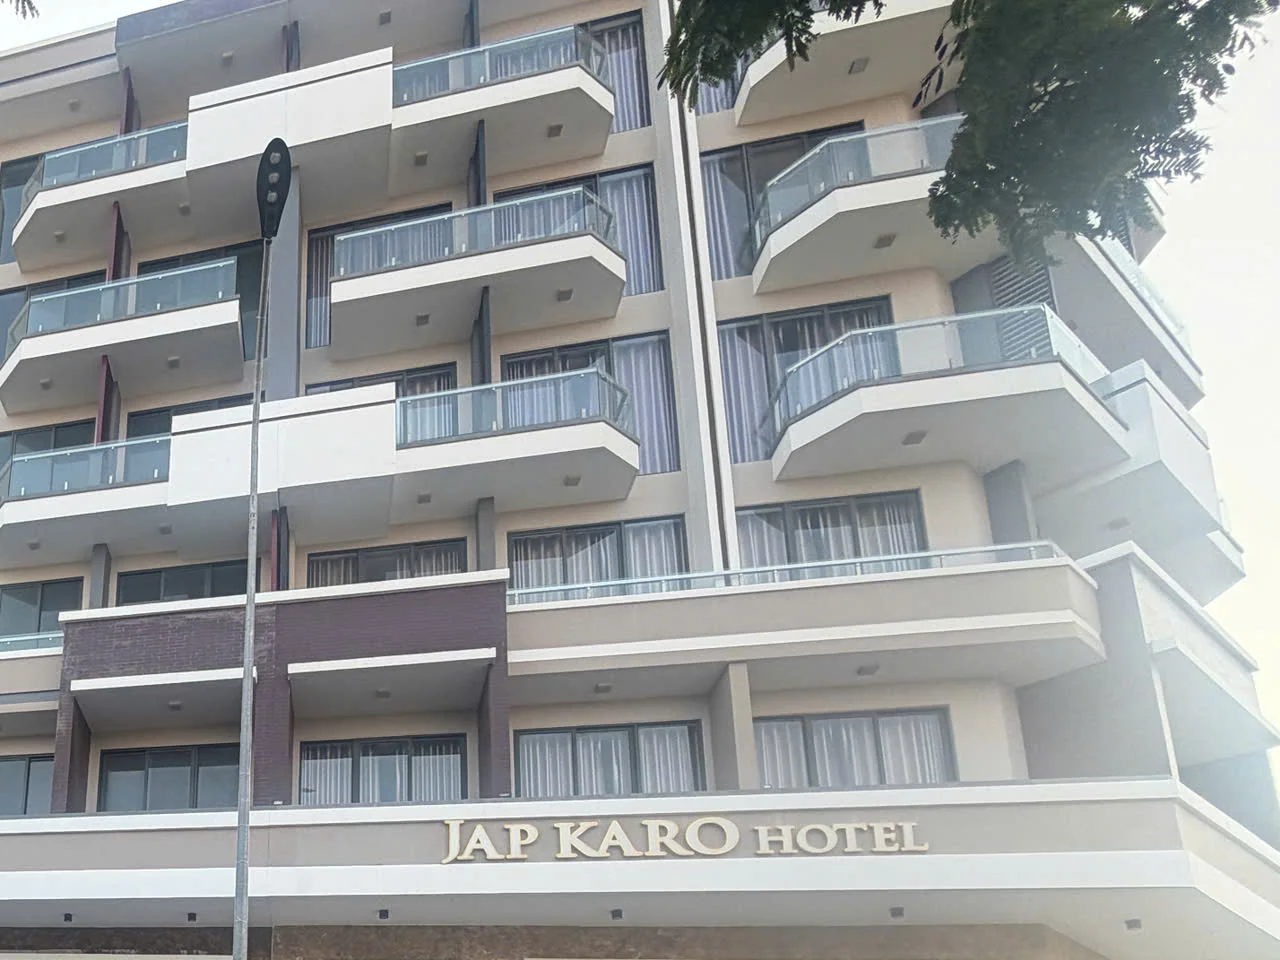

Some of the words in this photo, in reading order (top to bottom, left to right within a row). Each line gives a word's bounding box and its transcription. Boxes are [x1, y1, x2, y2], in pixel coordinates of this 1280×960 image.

[442, 819, 539, 864] JAP
[553, 817, 740, 858] KARO
[754, 822, 928, 854] HOTEL
